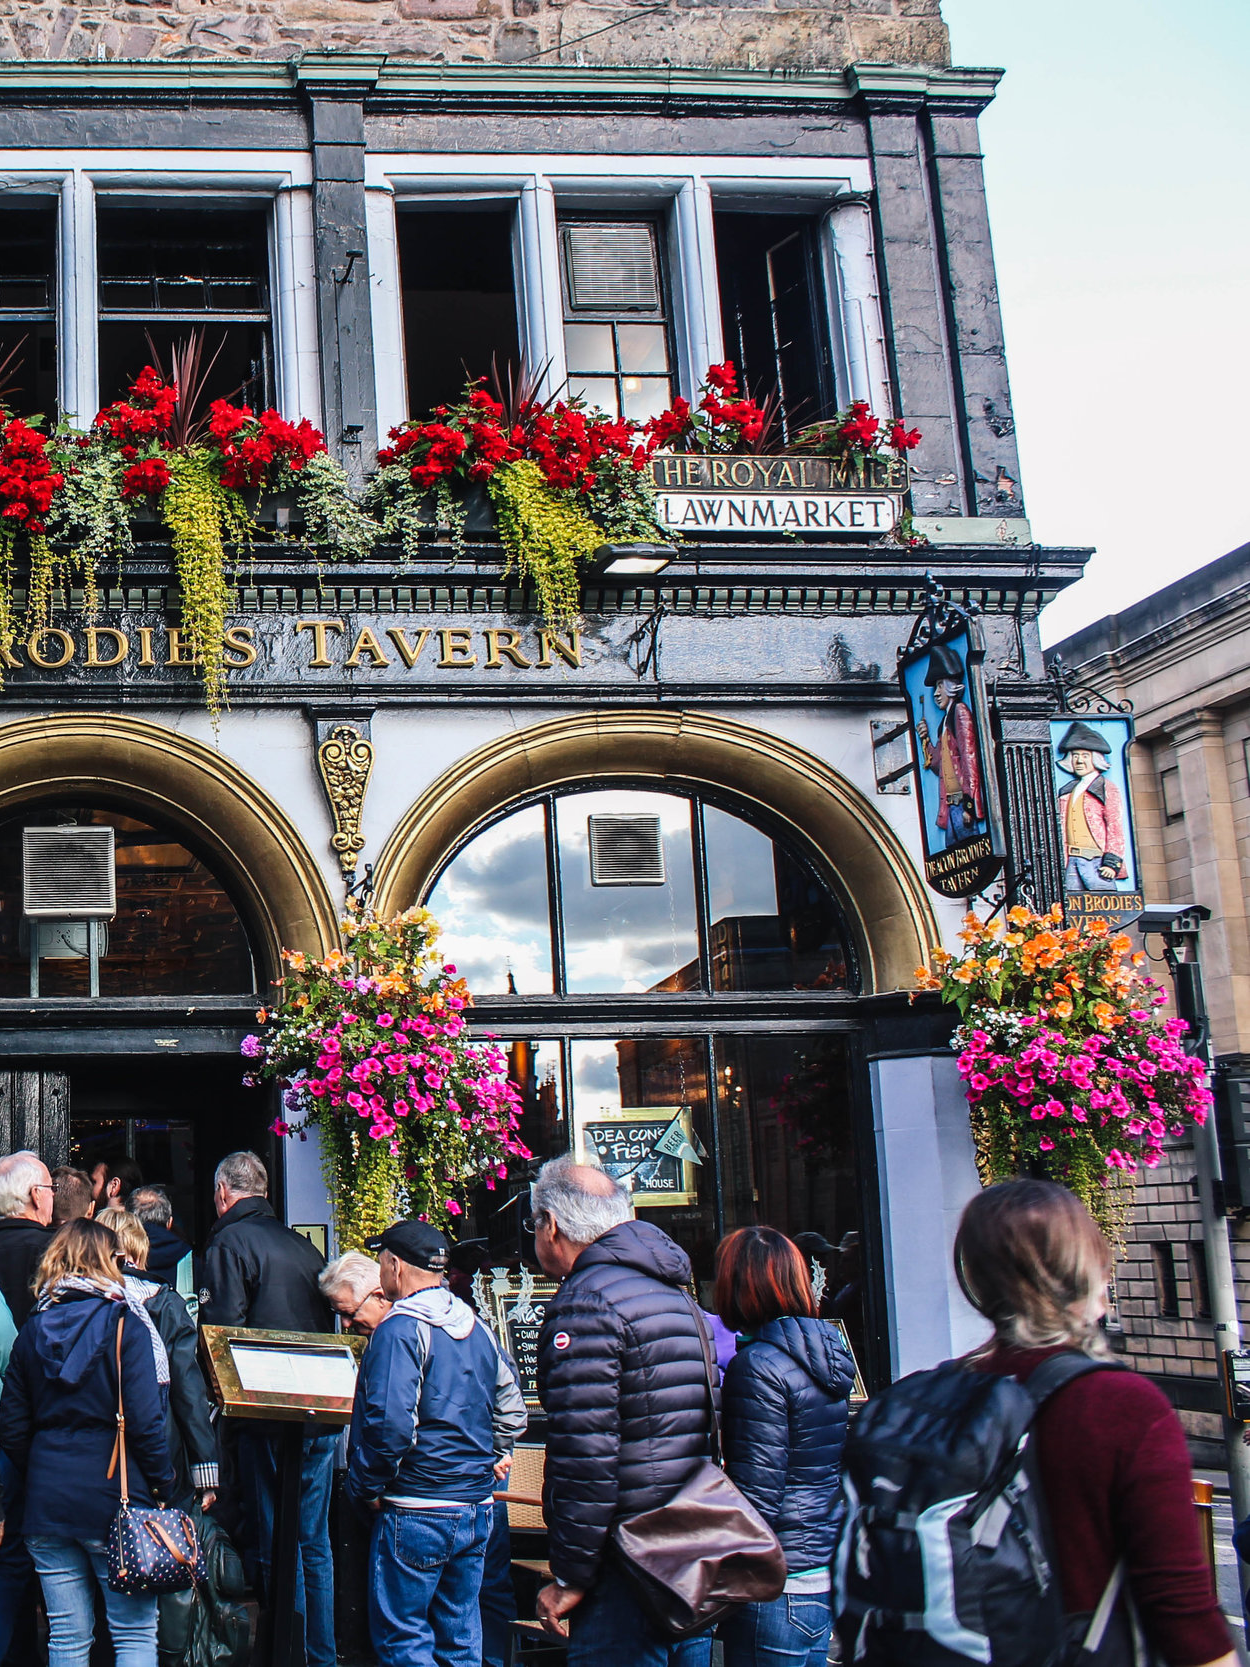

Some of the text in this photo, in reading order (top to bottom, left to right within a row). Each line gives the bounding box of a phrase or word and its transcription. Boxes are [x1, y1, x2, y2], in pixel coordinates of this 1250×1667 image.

[650, 459, 702, 486] THE
[711, 459, 815, 488] ROYAL
[664, 498, 885, 527] LAWNMARKET
[296, 620, 584, 669] TAVERN
[940, 866, 979, 892] TAVERN
[1083, 894, 1143, 912] BRODIE'S
[1070, 915, 1121, 929] VERN
[664, 1130, 682, 1151] BEER
[645, 1179, 675, 1189] HOUSE
